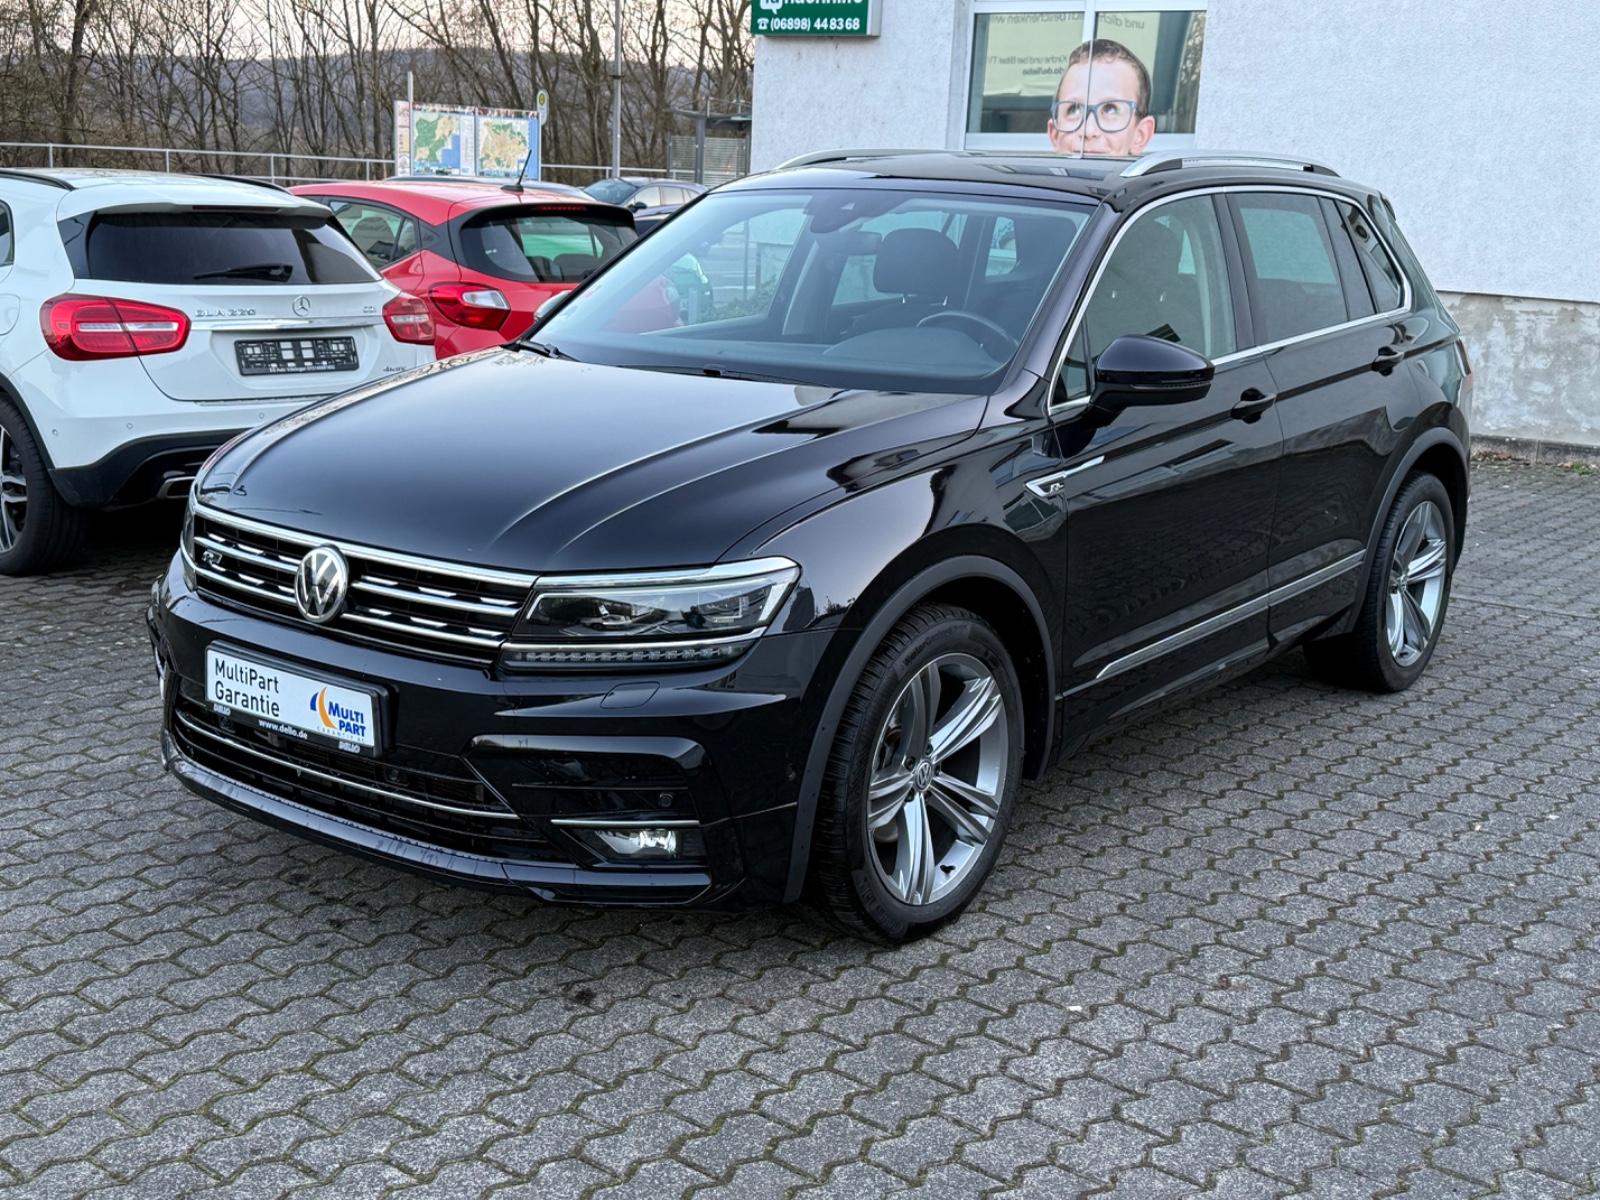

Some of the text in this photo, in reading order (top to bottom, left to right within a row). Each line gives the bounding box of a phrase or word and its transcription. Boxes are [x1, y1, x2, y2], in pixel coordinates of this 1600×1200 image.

[770, 17, 811, 31] (06898)
[215, 657, 280, 694] MultiPart
[214, 680, 280, 717] Garantie
[258, 719, 308, 740] www.dello.de
[339, 719, 367, 737] PART
